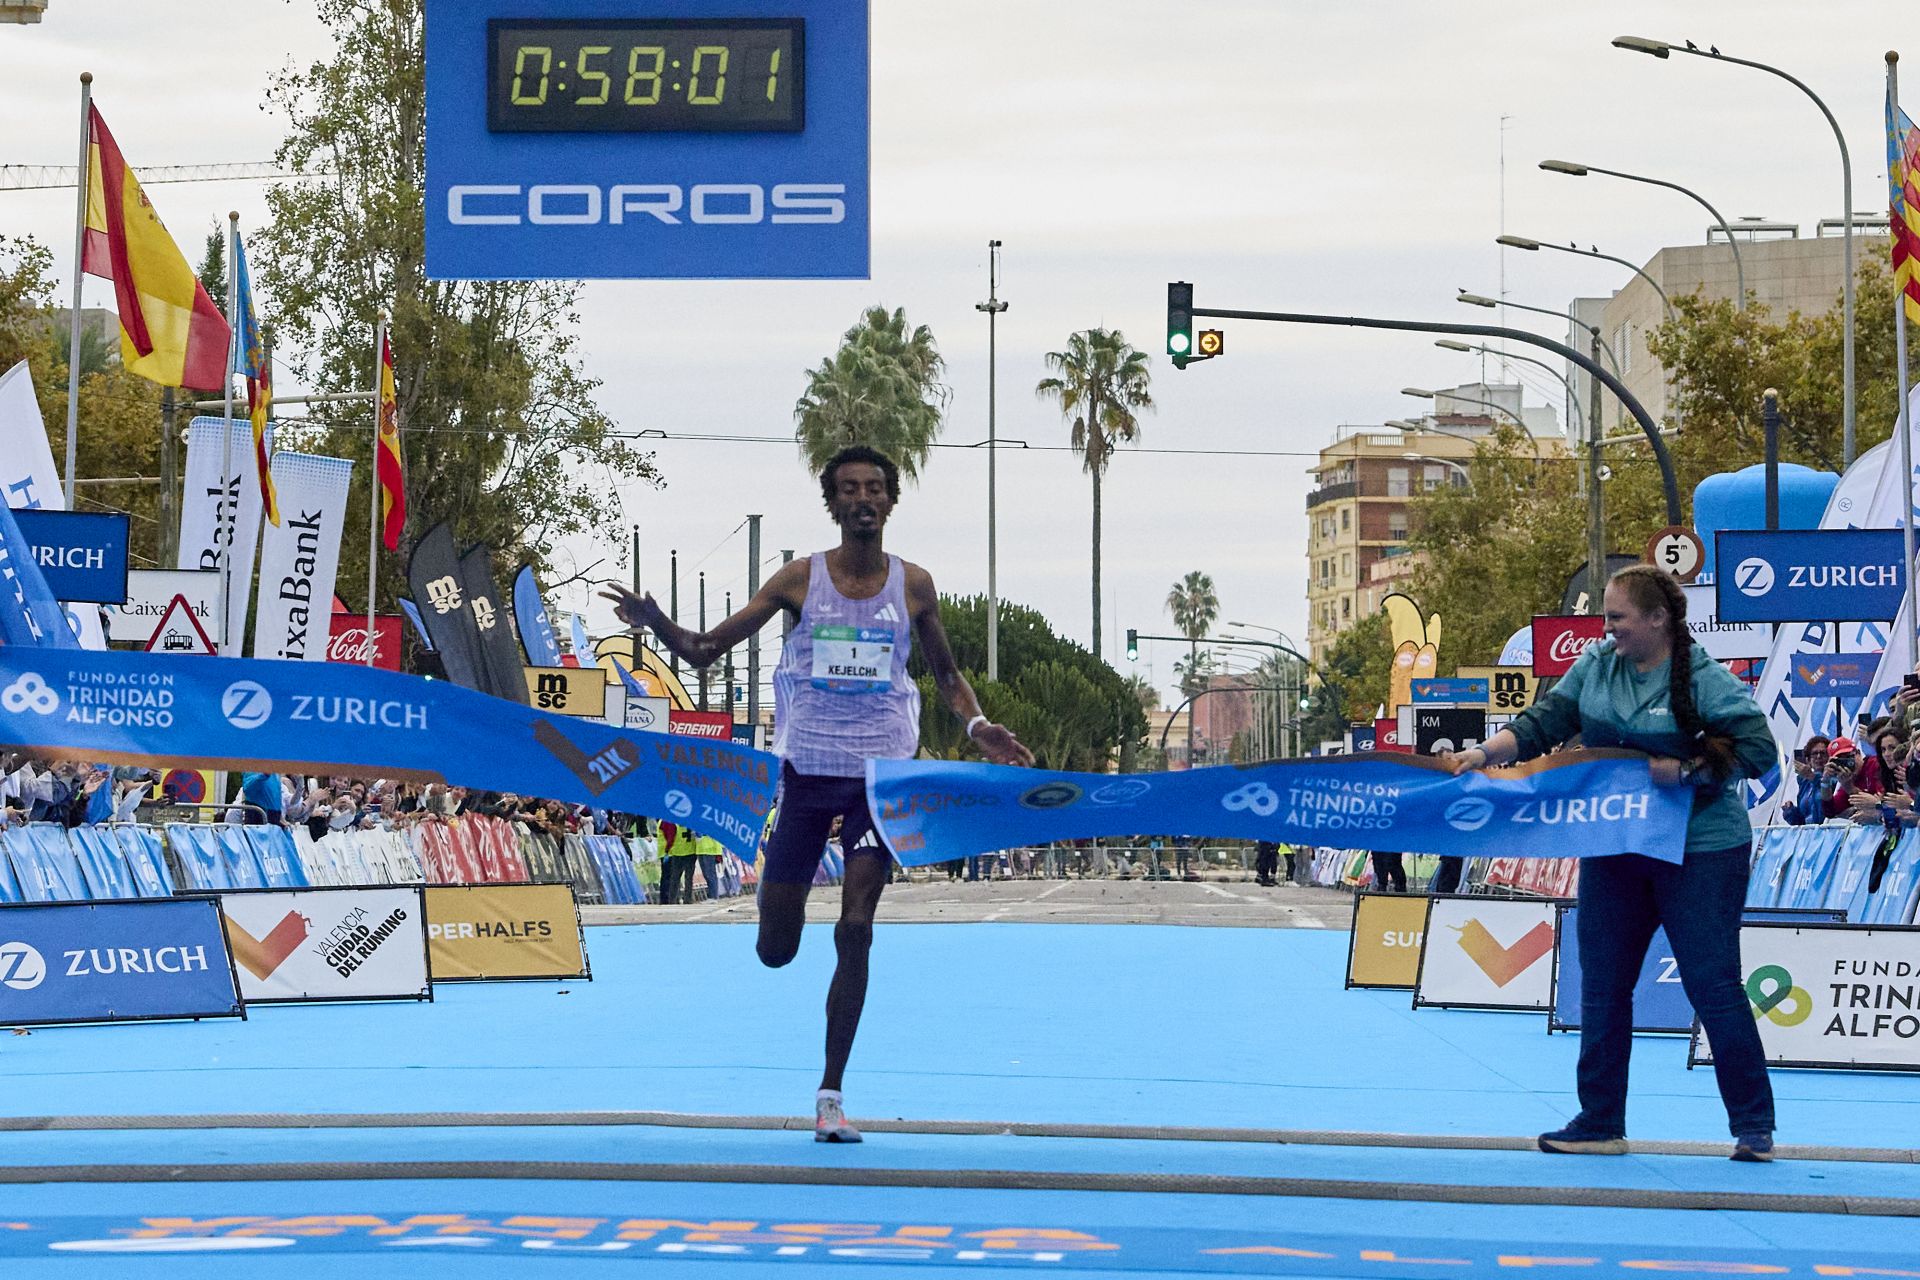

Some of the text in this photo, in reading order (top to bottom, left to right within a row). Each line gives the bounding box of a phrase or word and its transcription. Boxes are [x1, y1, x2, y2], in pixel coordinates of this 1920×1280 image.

[511, 46, 781, 105] 0:58:01
[448, 184, 846, 225] COROS
[1788, 565, 1897, 587] ZURICH
[120, 597, 210, 617] Caixank
[851, 648, 856, 658] 1
[68, 671, 174, 686] FUNDACIÓN
[828, 665, 878, 677] KEJELCHA
[67, 686, 174, 707] TRINIDAD
[66, 706, 174, 728] ALFONSO
[290, 695, 428, 729] ZURICH
[1422, 716, 1440, 727] KM
[588, 747, 632, 784] 21K
[657, 742, 769, 786] VALENCIA
[1288, 788, 1397, 816] TRINIDAD
[1511, 794, 1649, 824] ZURICH
[702, 804, 756, 848] ZURICH
[1285, 810, 1393, 829] ALFONSO
[315, 907, 369, 958] VALENCIA
[326, 924, 370, 968] CIUDAD
[336, 908, 408, 979] DEL RUNNING
[64, 945, 209, 976] ZURICH
